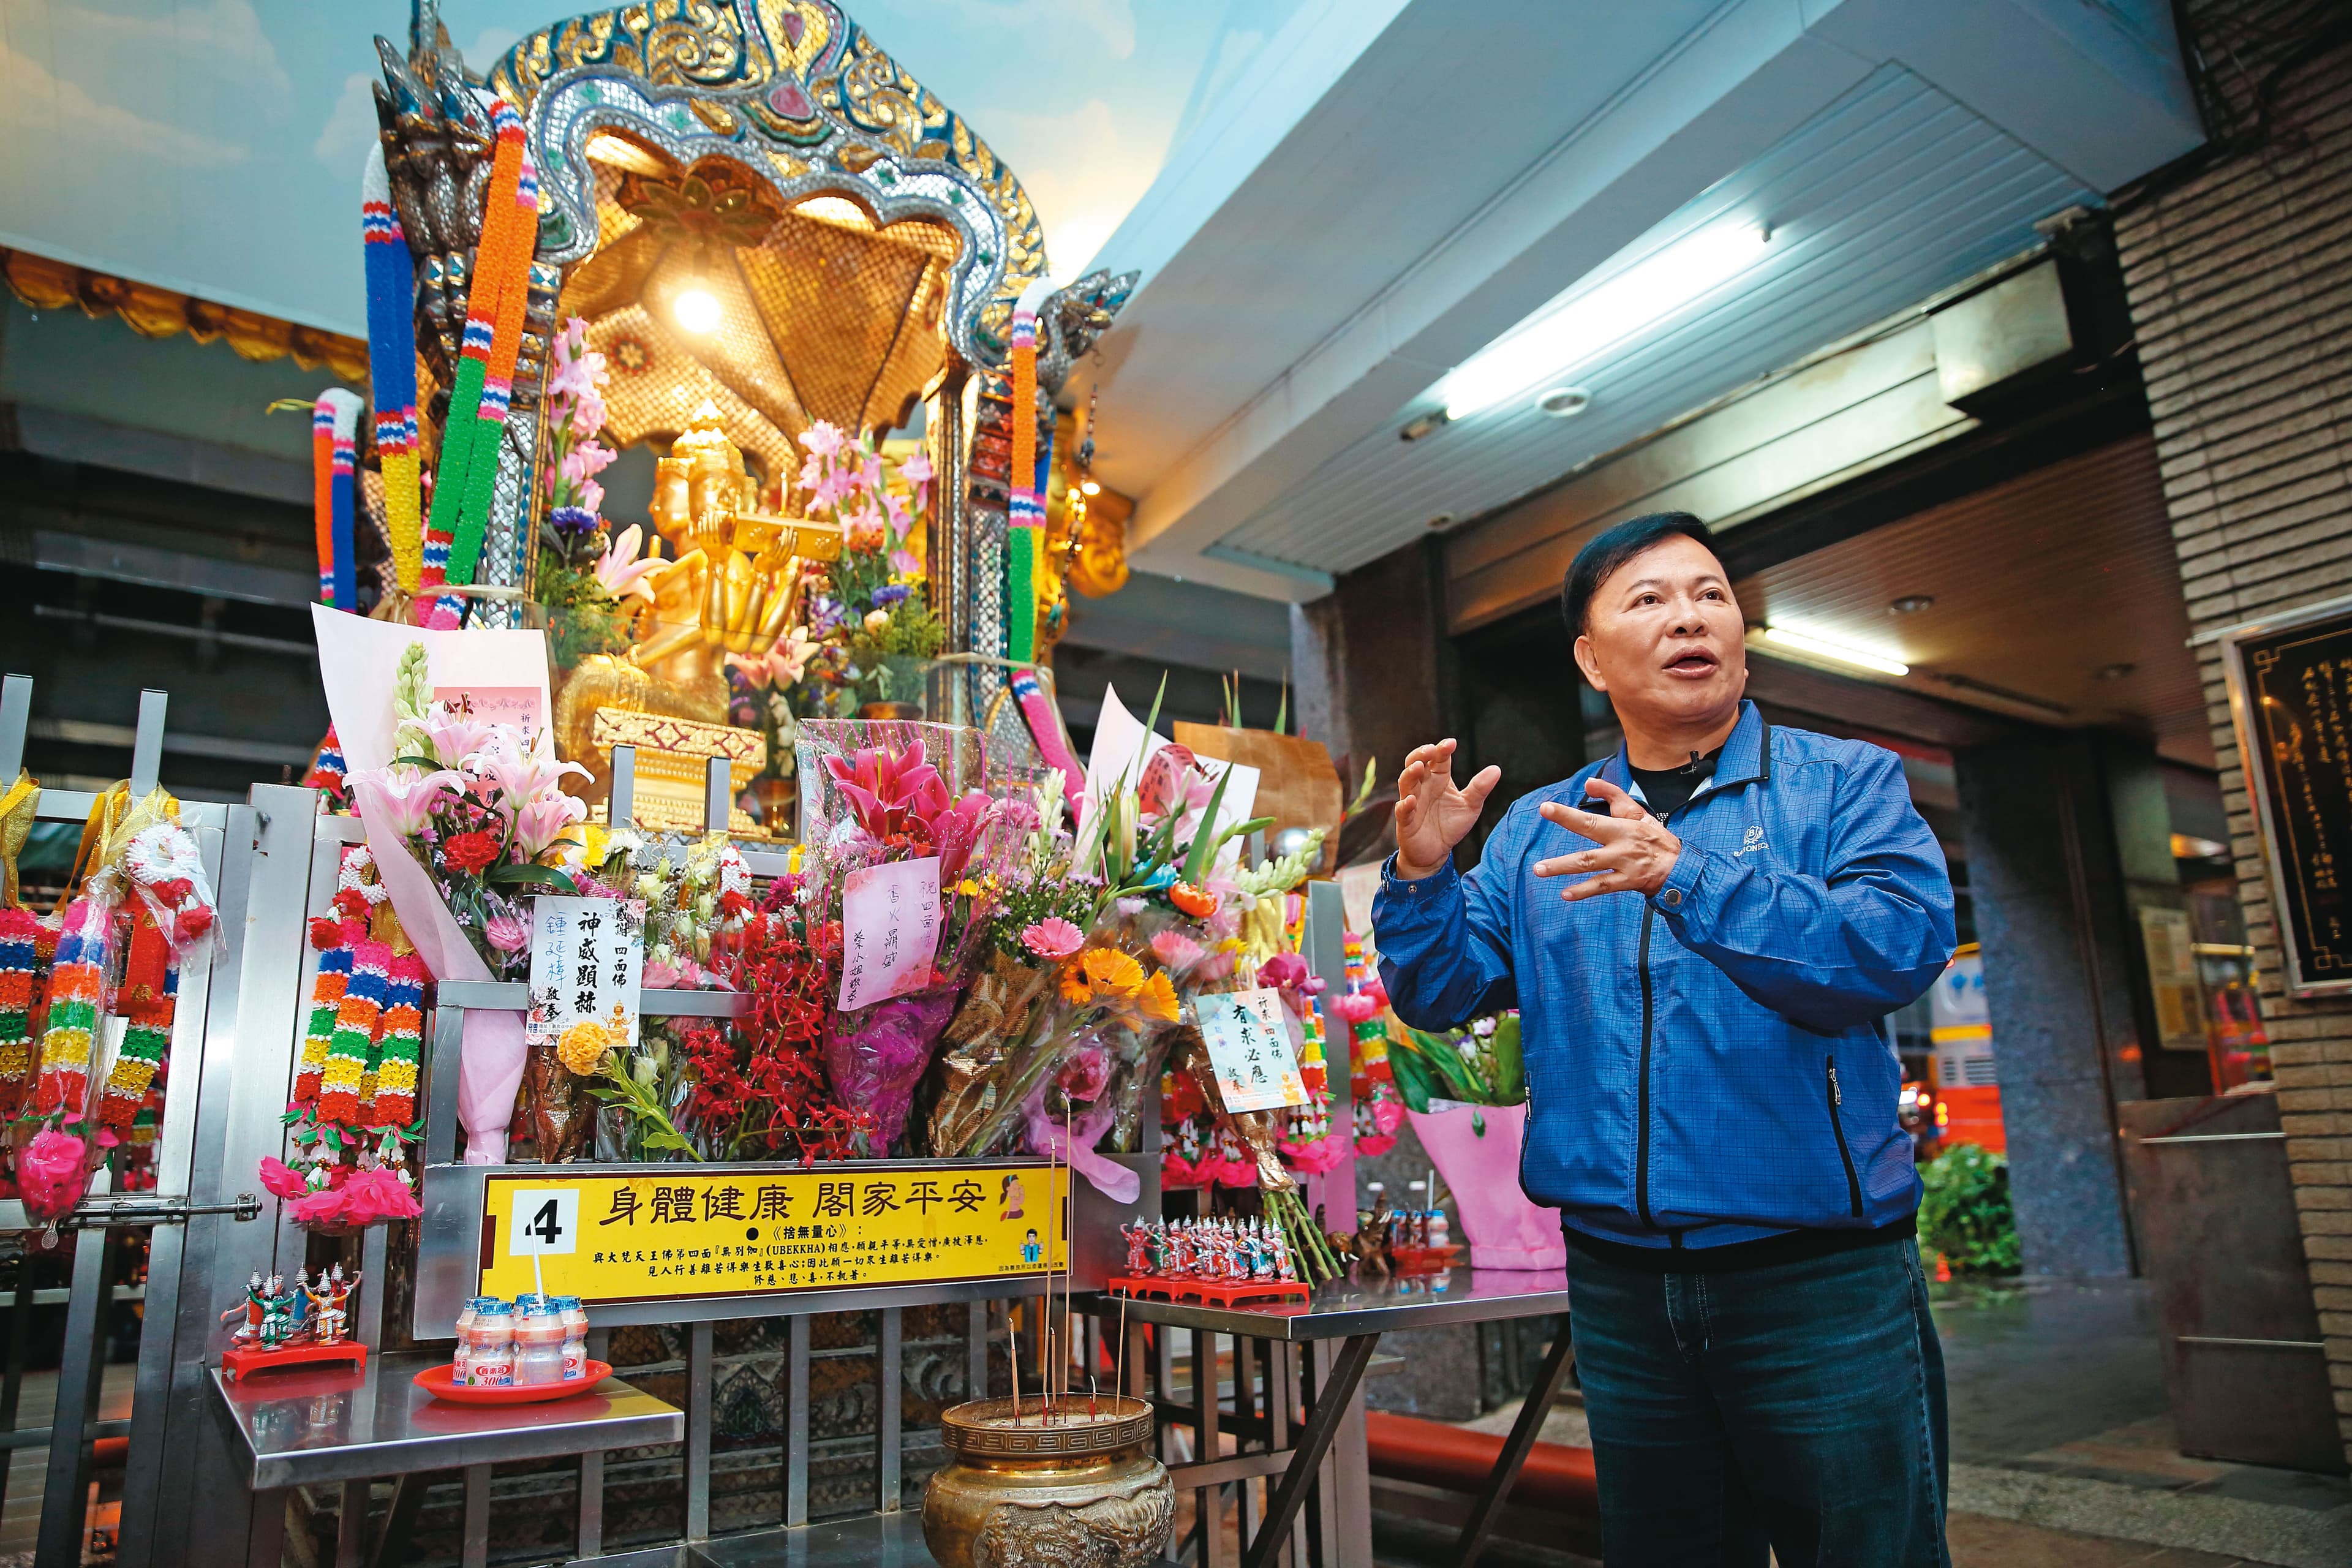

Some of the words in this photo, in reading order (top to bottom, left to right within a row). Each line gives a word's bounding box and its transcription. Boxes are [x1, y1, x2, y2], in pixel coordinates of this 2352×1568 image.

[614, 902, 629, 937] 感謝
[574, 911, 601, 1014] 神威顯赫
[612, 946, 628, 989] 四面佛
[1233, 1005, 1268, 1084] 有求必應
[1265, 1028, 1283, 1061] 四面佛
[525, 1199, 562, 1244] 4
[598, 1183, 794, 1226] 身體健康
